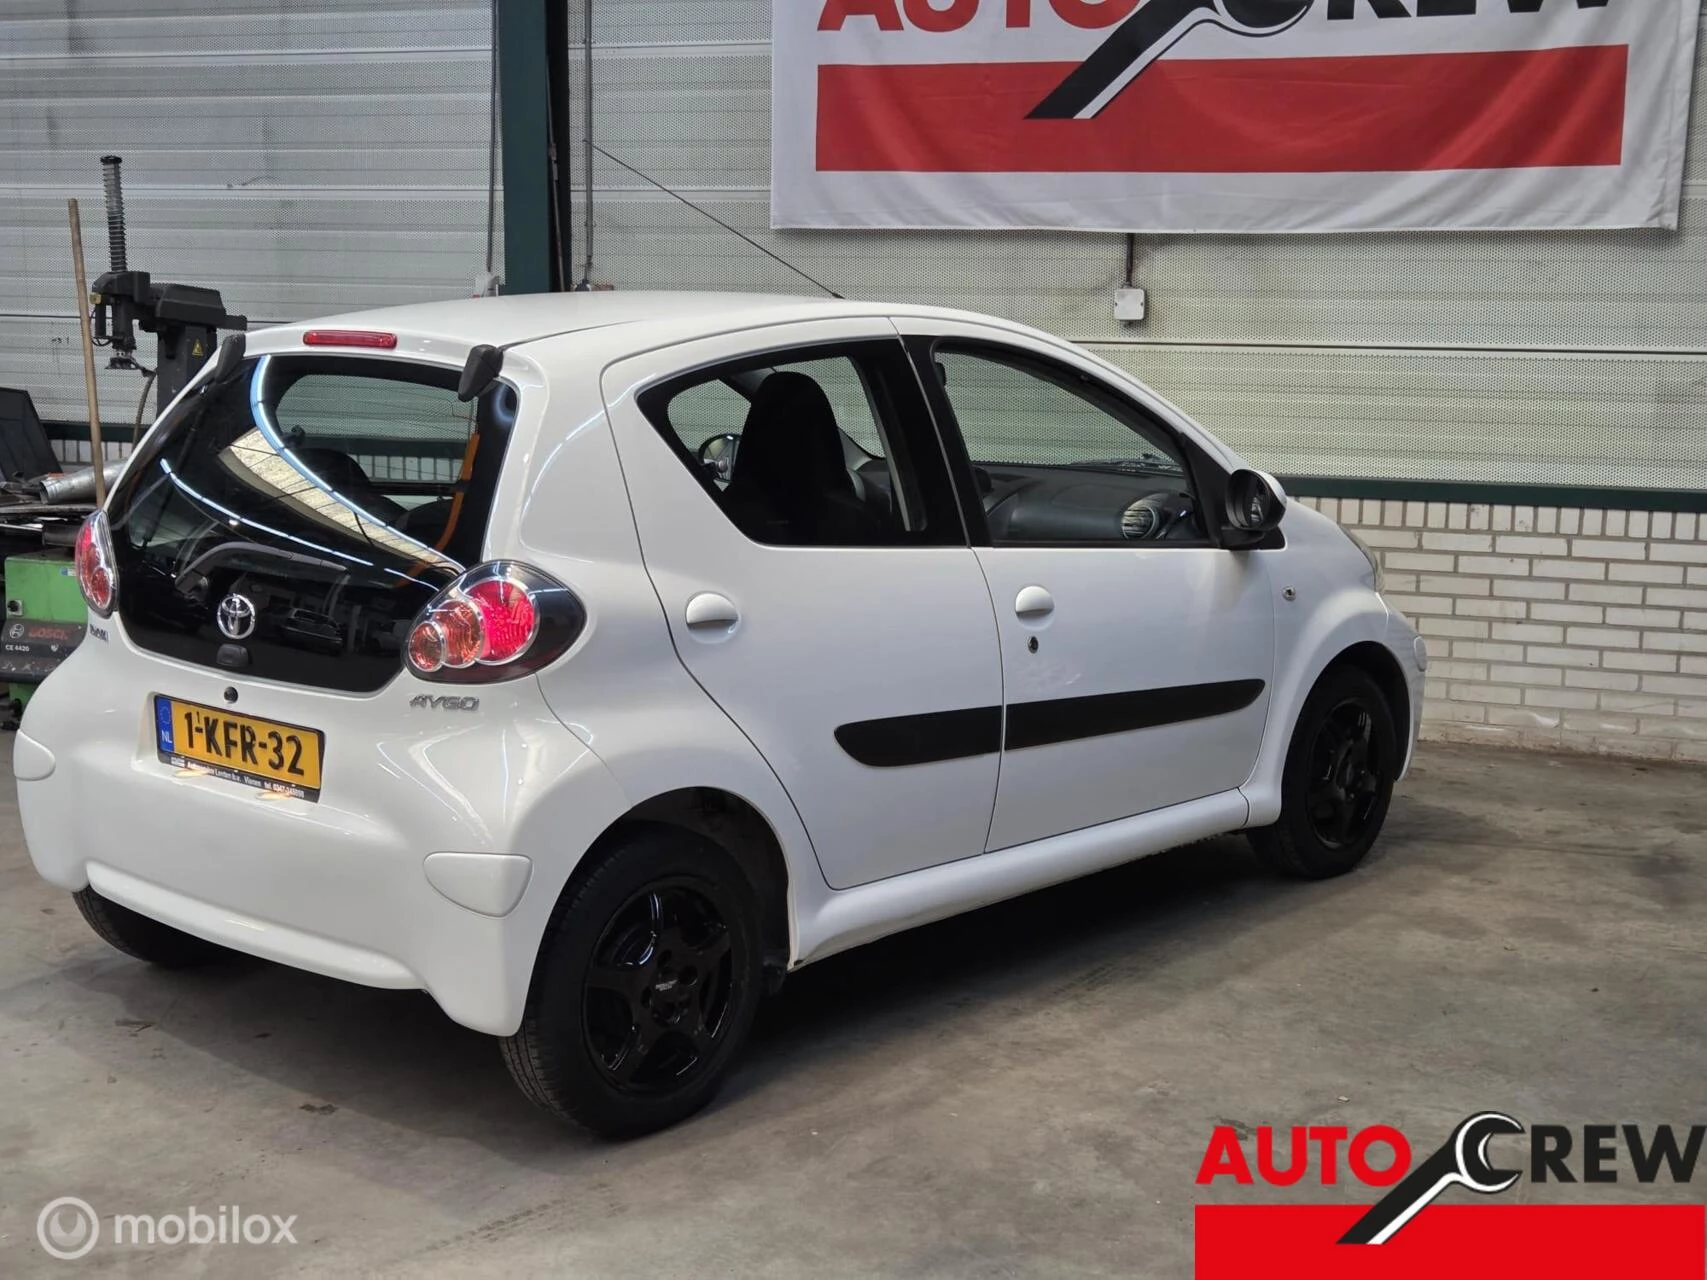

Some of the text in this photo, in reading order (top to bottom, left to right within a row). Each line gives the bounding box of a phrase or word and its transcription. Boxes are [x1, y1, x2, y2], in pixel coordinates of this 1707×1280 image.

[409, 694, 480, 711] AYGO
[161, 729, 173, 744] NL
[184, 711, 304, 776] 1-KFR-32
